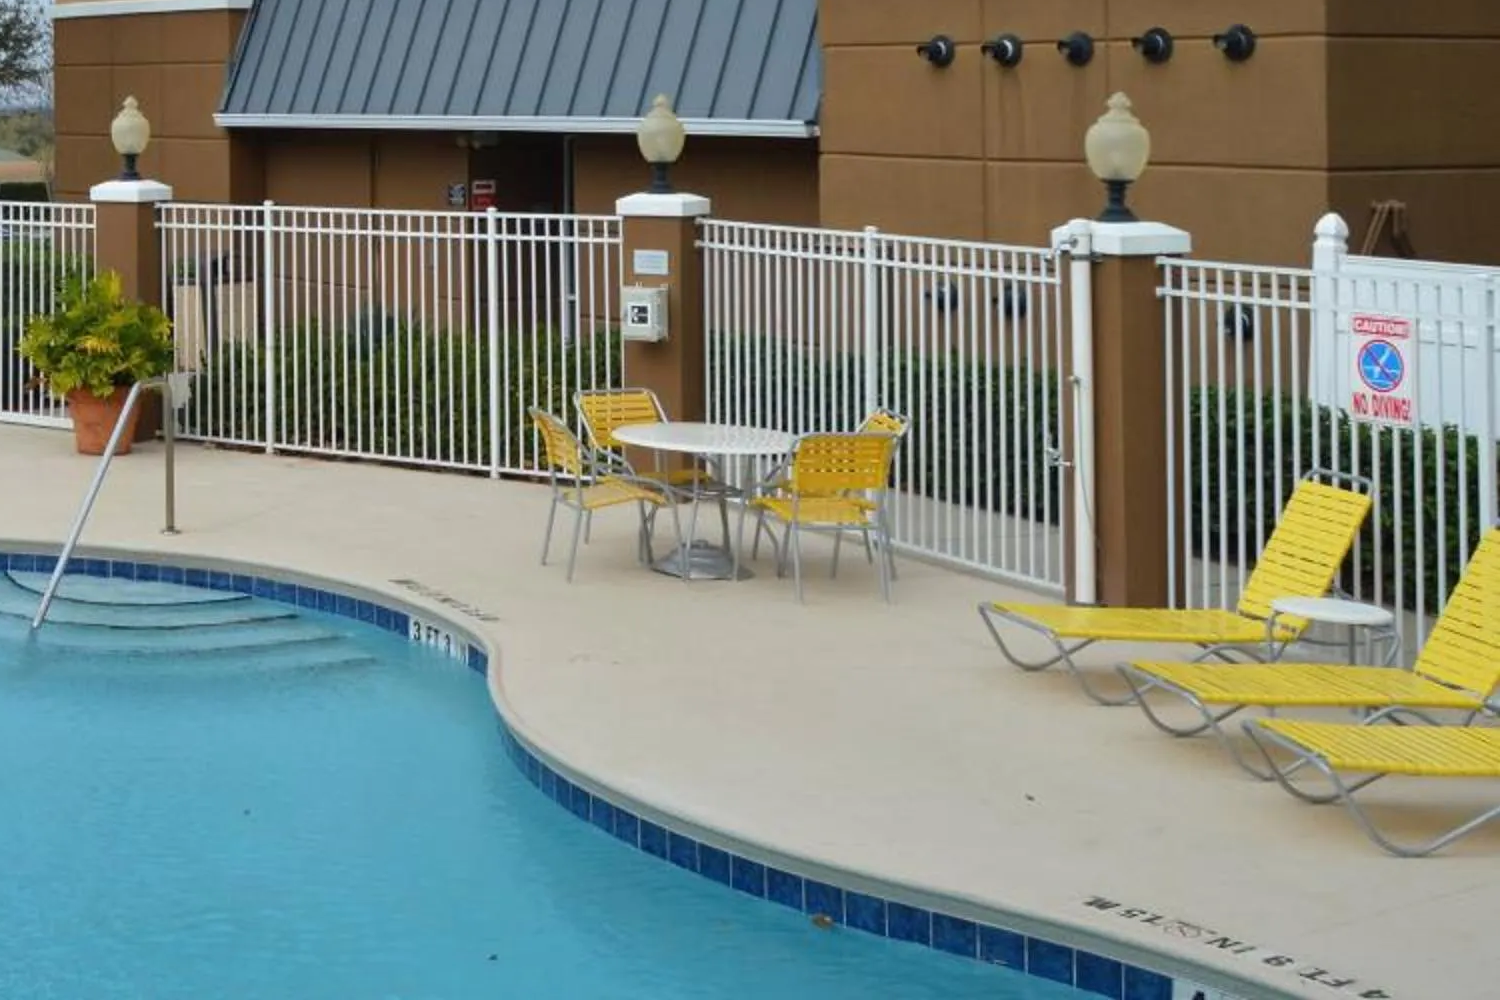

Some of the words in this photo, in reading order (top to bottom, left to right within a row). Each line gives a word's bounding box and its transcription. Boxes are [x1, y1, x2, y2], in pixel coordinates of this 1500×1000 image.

[1352, 393, 1369, 416] NO
[413, 620, 421, 642] 3
[1205, 936, 1256, 954] IN
[1299, 966, 1355, 990] FT
